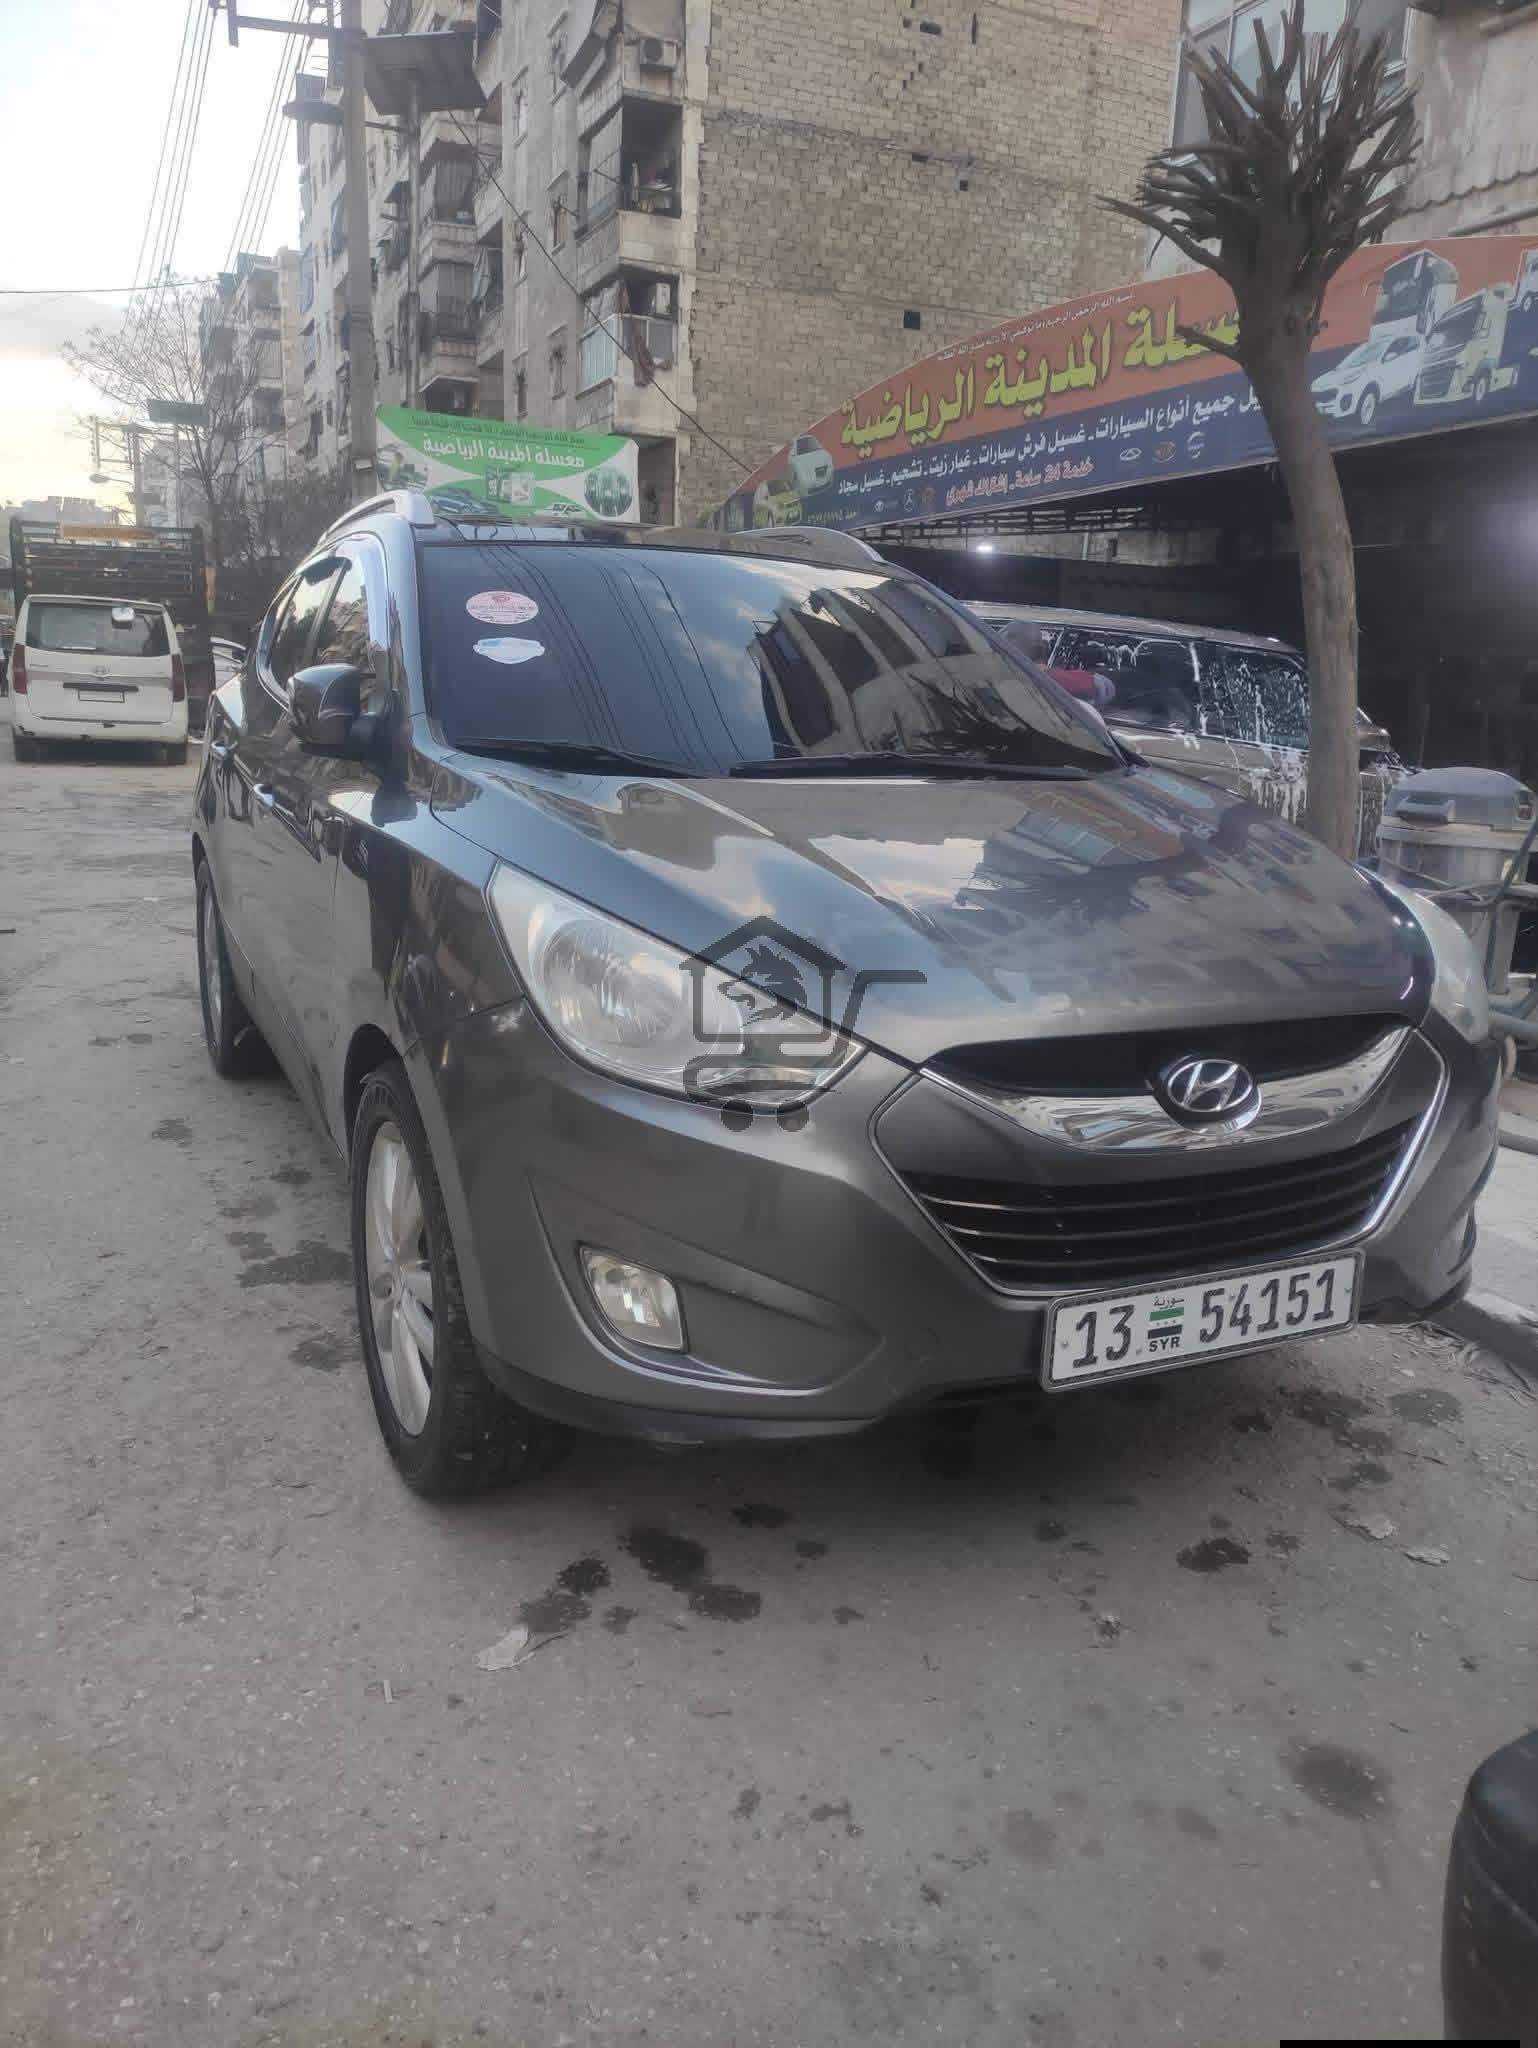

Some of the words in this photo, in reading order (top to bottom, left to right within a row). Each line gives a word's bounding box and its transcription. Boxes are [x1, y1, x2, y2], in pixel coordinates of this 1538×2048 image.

[984, 318, 1112, 417] المدينة
[841, 363, 974, 458] الرياضية
[1095, 407, 1154, 440] السيارات
[1192, 395, 1235, 425] جميع
[1018, 433, 1045, 460] فرش
[1048, 422, 1086, 453] غسيل
[978, 443, 1016, 465] سيارات
[1072, 1303, 1137, 1369] 13
[1199, 1267, 1336, 1344] 54151
[1148, 1335, 1181, 1352] SYR
